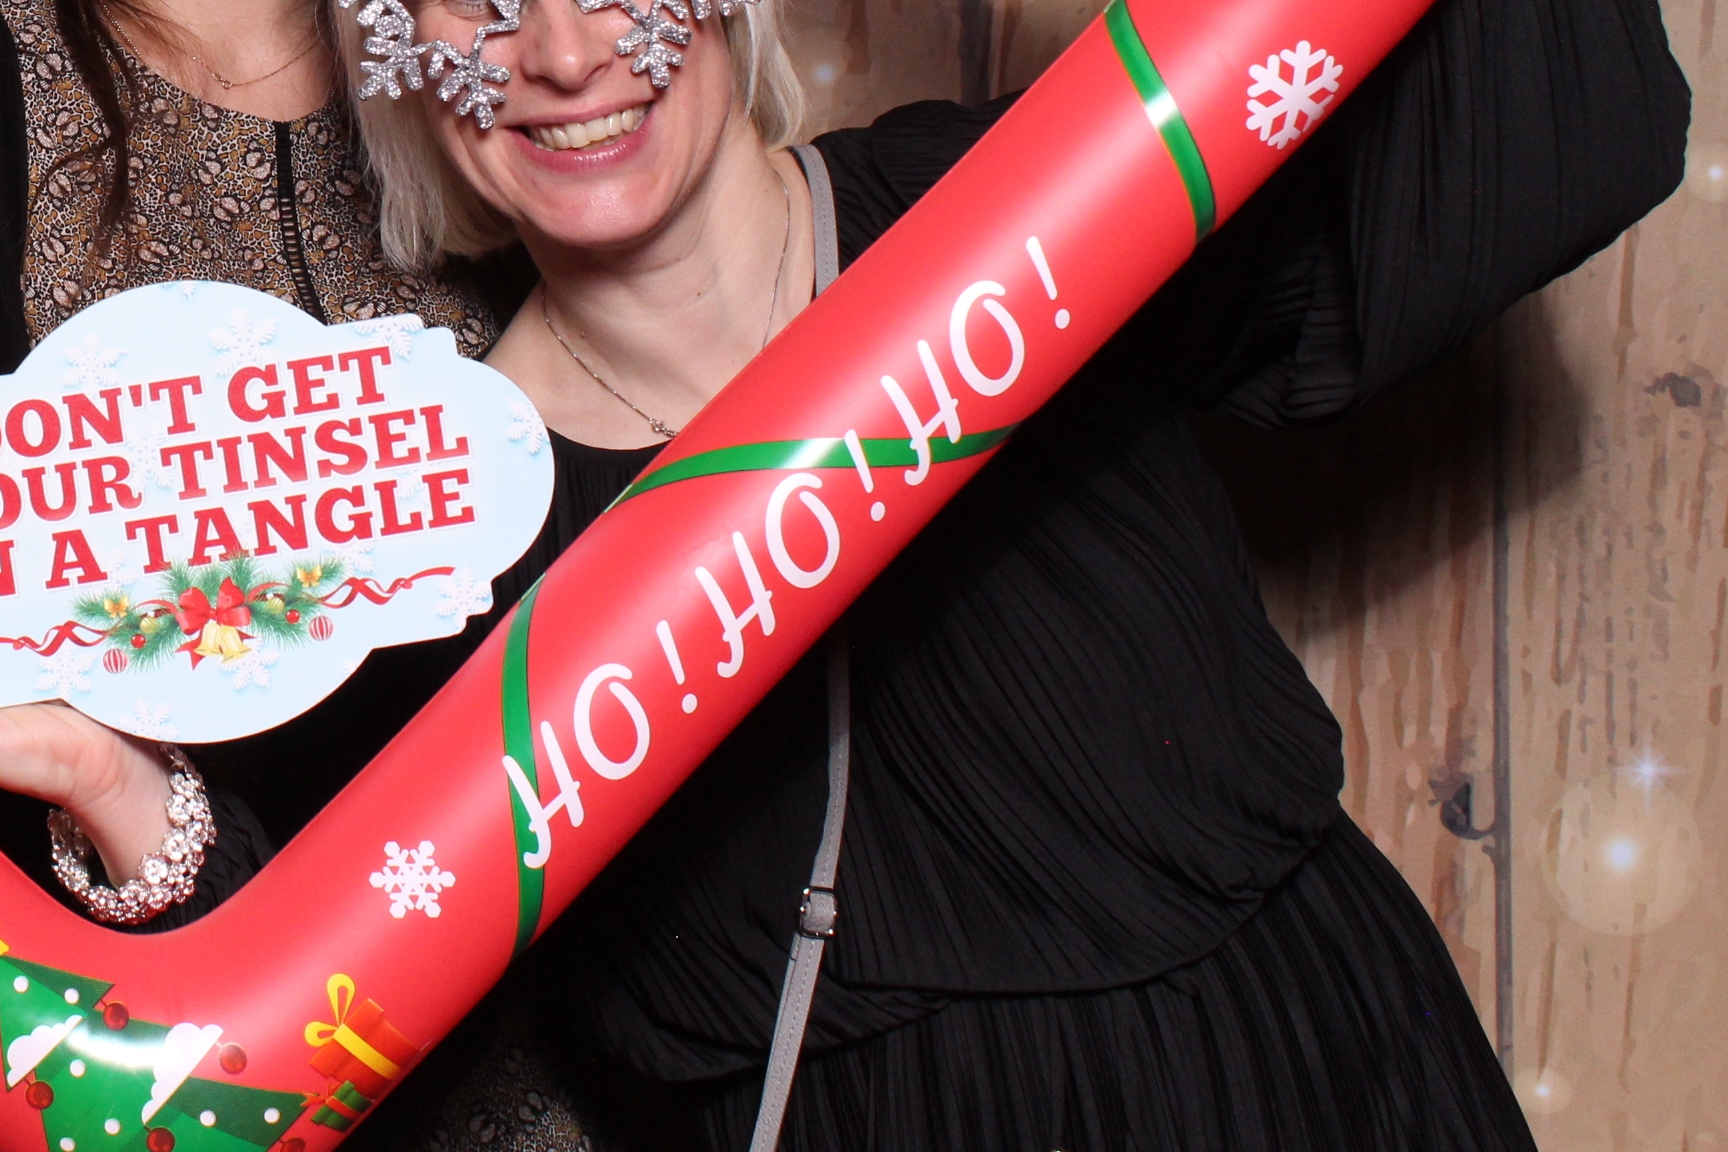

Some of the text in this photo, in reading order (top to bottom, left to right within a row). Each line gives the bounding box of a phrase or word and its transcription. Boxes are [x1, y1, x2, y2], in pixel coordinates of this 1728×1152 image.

[227, 345, 392, 423] GET
[161, 404, 469, 501] TINSEL
[46, 529, 109, 590] A
[126, 468, 476, 575] TANGLE
